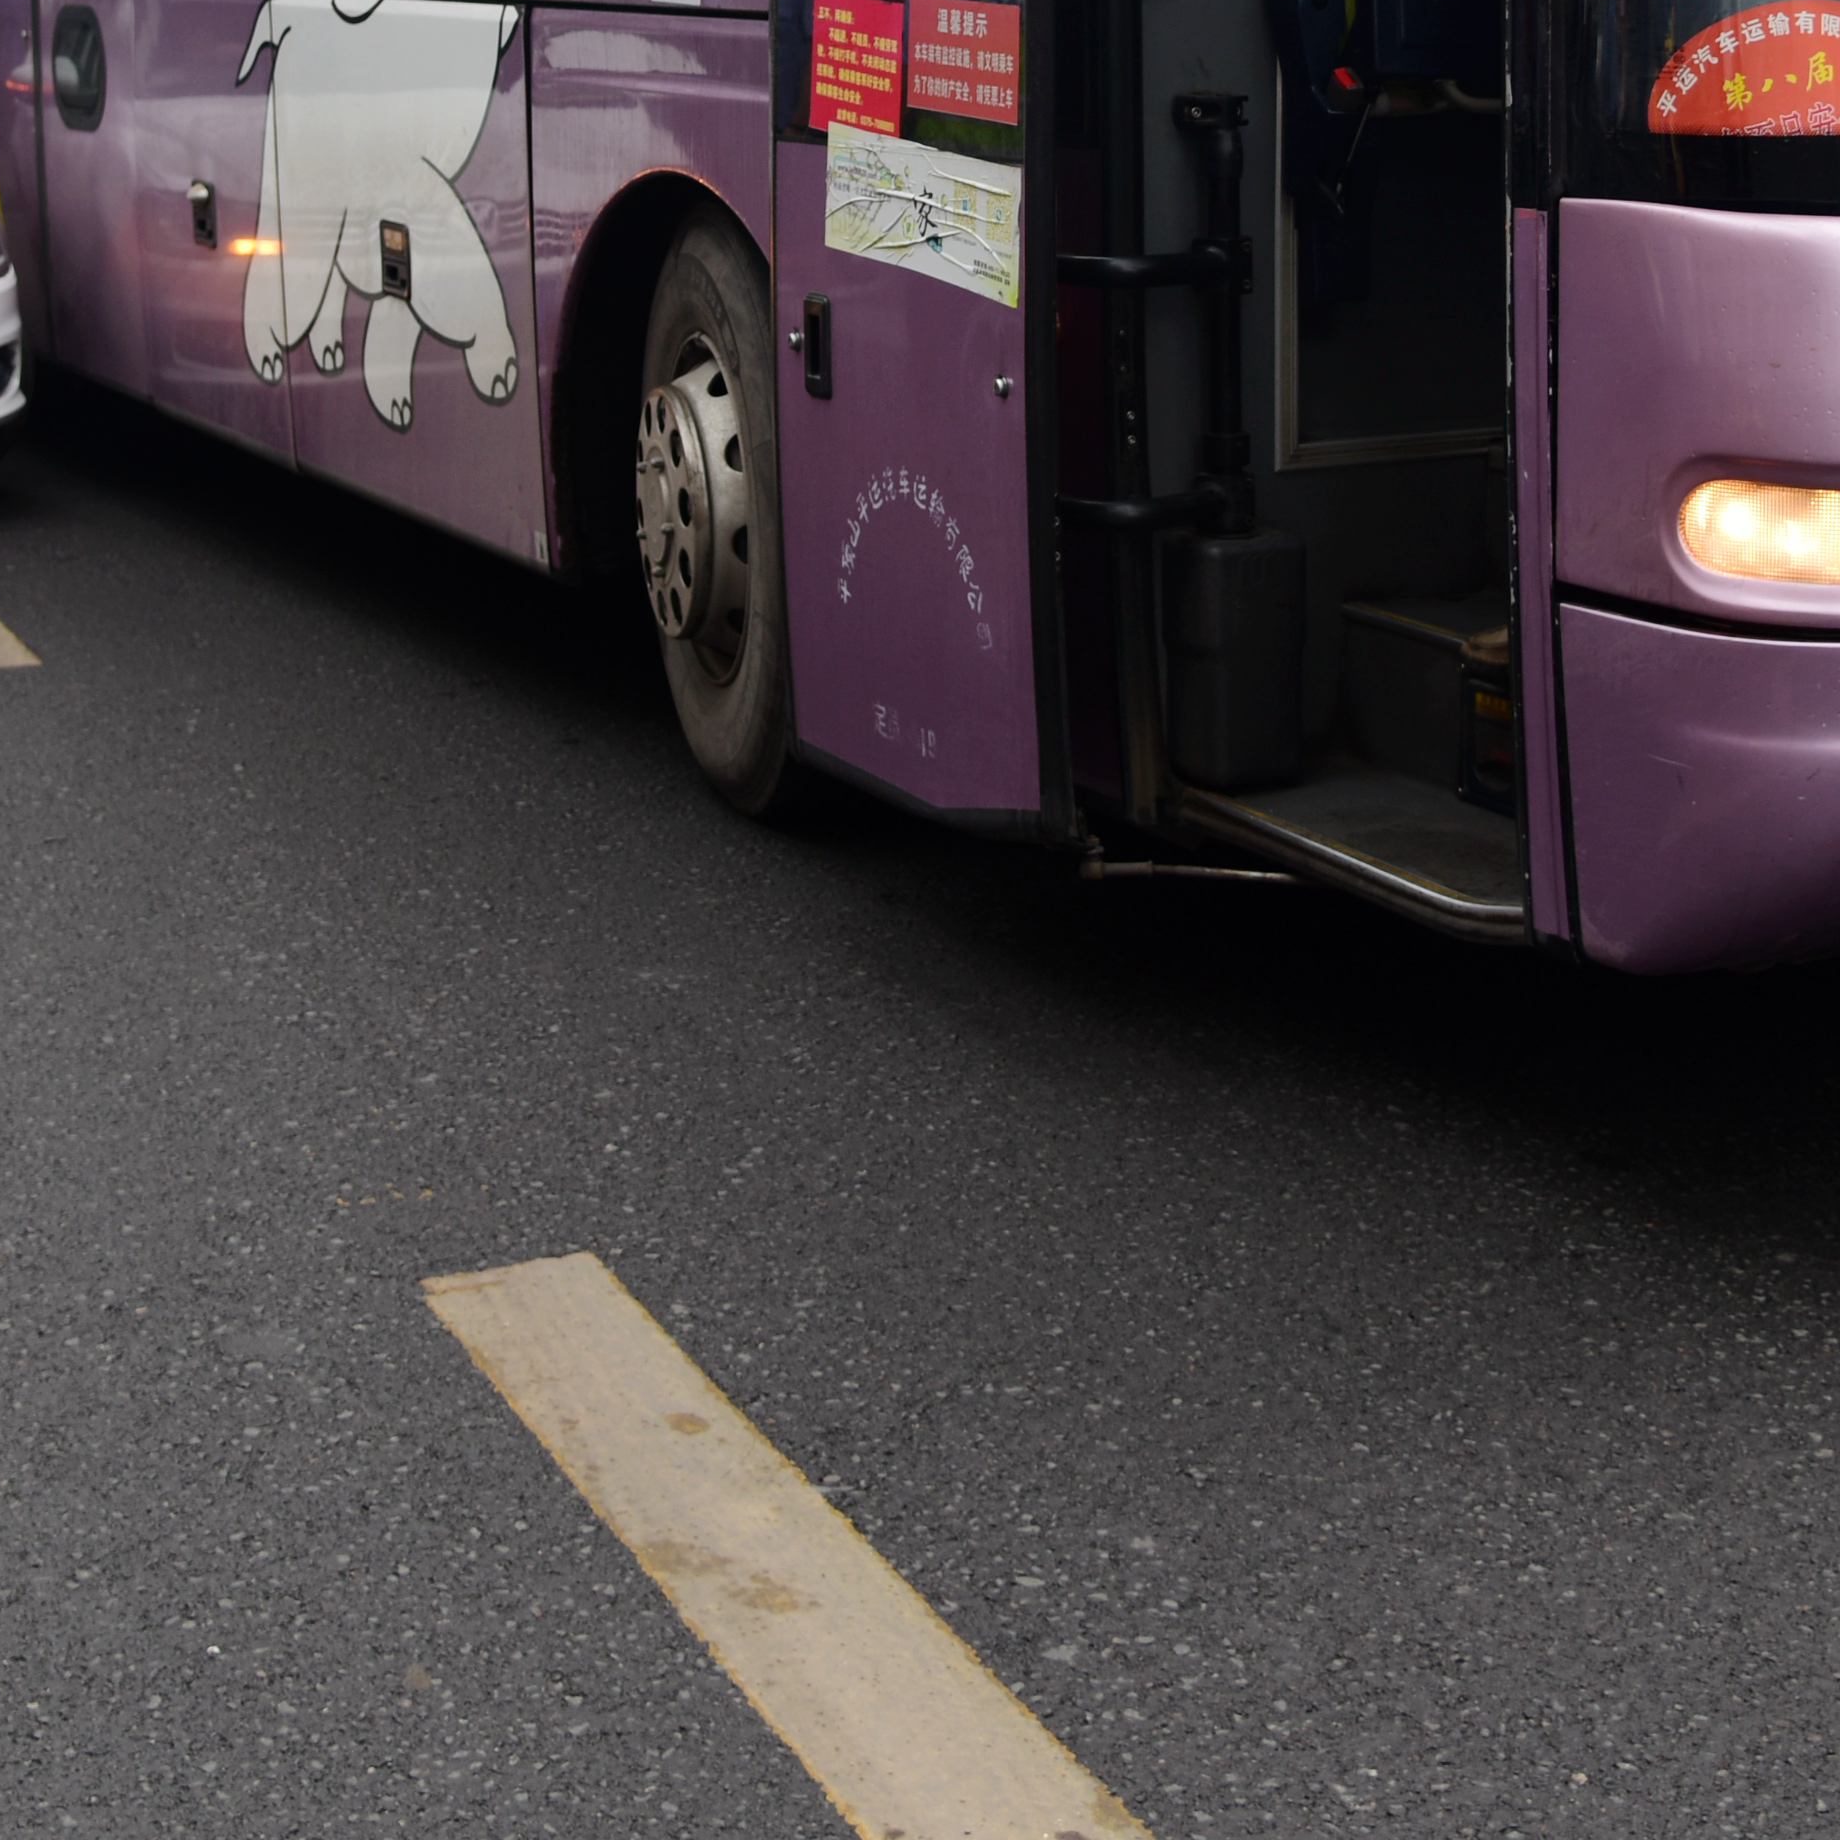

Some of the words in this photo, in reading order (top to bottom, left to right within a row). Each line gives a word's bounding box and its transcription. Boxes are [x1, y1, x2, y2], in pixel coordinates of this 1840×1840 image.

[937, 7, 988, 39] 温馨提示
[1722, 50, 1836, 112] 第八届
